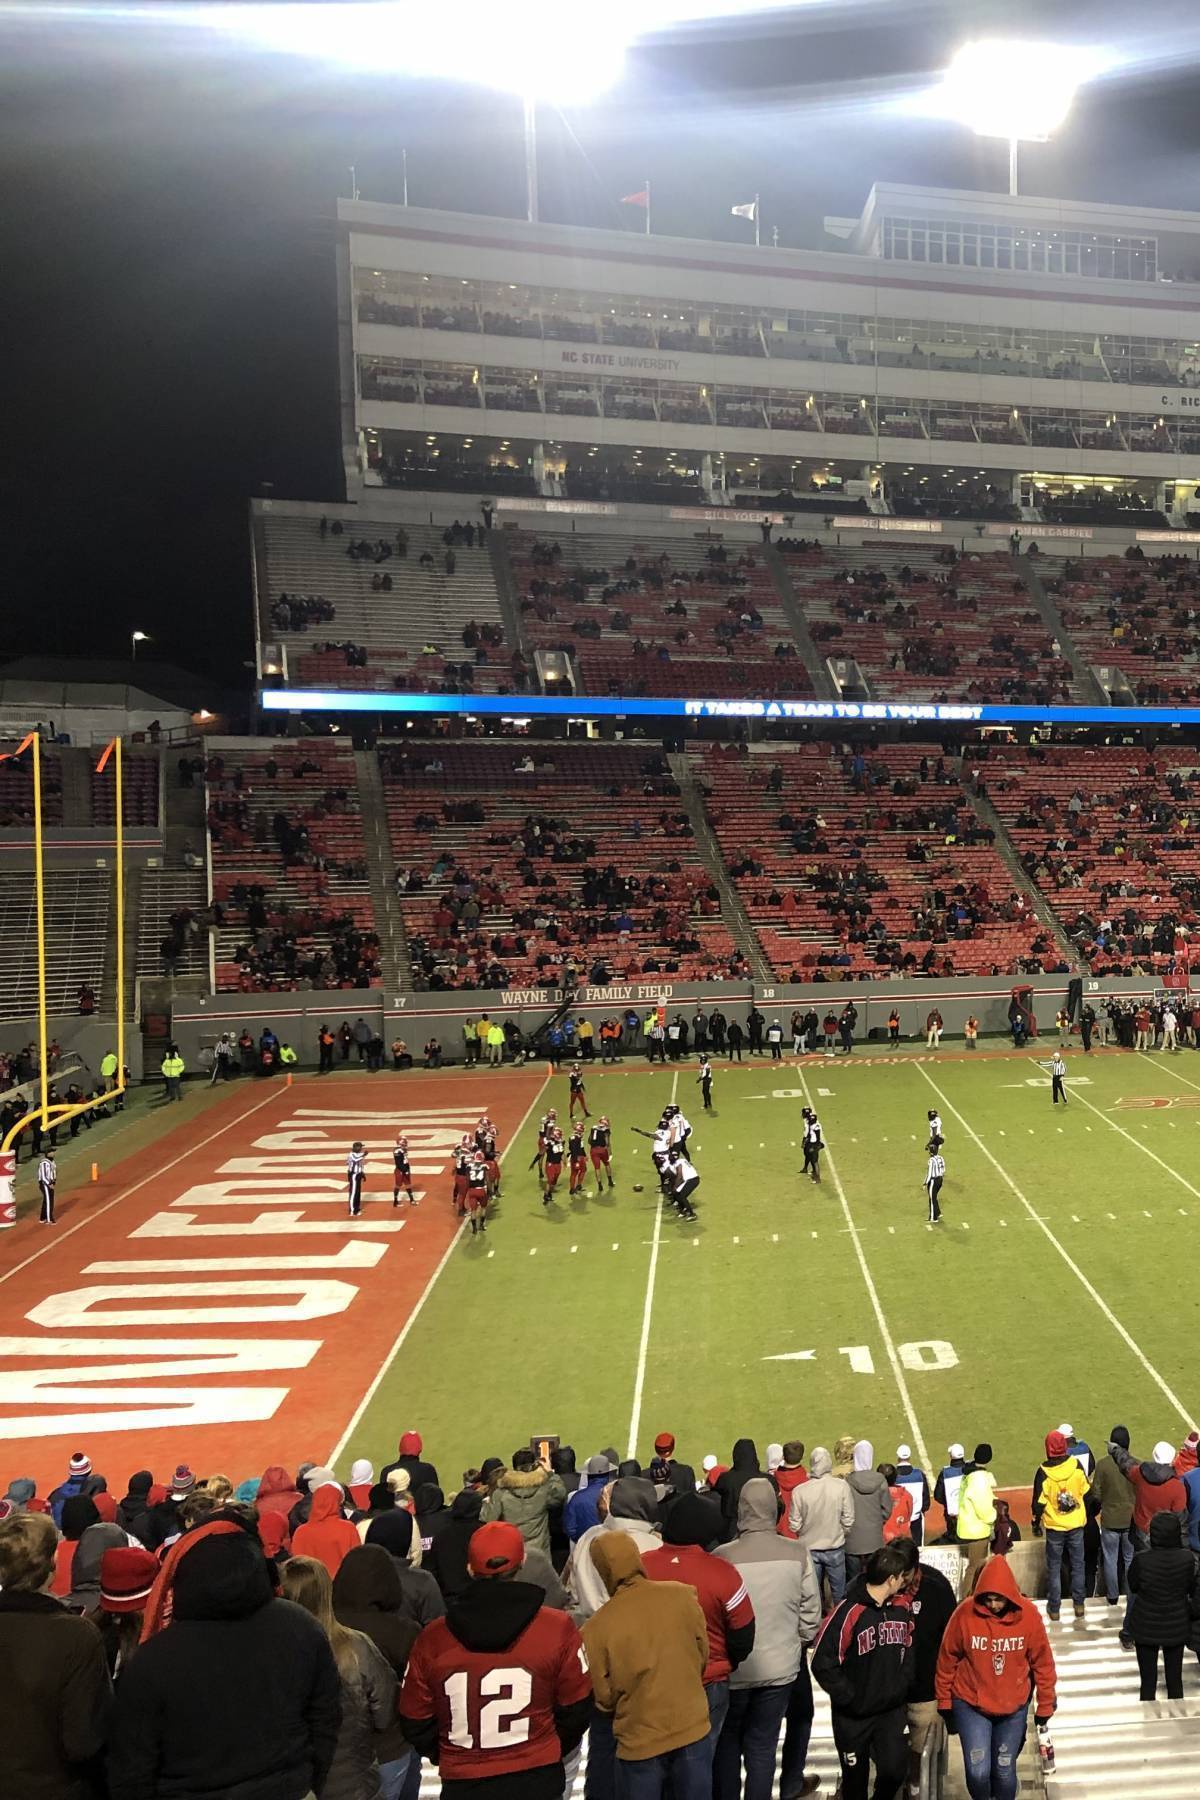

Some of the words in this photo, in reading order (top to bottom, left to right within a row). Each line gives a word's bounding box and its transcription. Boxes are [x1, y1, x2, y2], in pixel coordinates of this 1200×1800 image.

[561, 350, 578, 364] NC
[582, 352, 614, 366] STATE
[618, 356, 681, 371] UNIVERSITY
[1161, 395, 1174, 406] C.
[1048, 528, 1092, 538] GABRIEL
[684, 702, 703, 715] IT
[767, 703, 782, 716] A
[782, 703, 833, 717] TEAM
[835, 704, 862, 717] TO
[889, 706, 936, 719] YOUR
[501, 990, 548, 1004] WAYNE
[586, 986, 633, 1000] FAMILY
[637, 985, 674, 998] FIELD
[762, 988, 775, 998] 18
[1088, 981, 1099, 991] 19
[393, 997, 406, 1008] 17
[770, 1087, 837, 1098] 10
[469, 1169, 485, 1181] 24
[0, 1106, 489, 1439] WOLFPACK
[838, 1340, 960, 1375] 10
[856, 1625, 877, 1656] NC
[971, 1635, 988, 1651] NC
[990, 1636, 1025, 1652] STATE
[444, 1667, 532, 1749] 12
